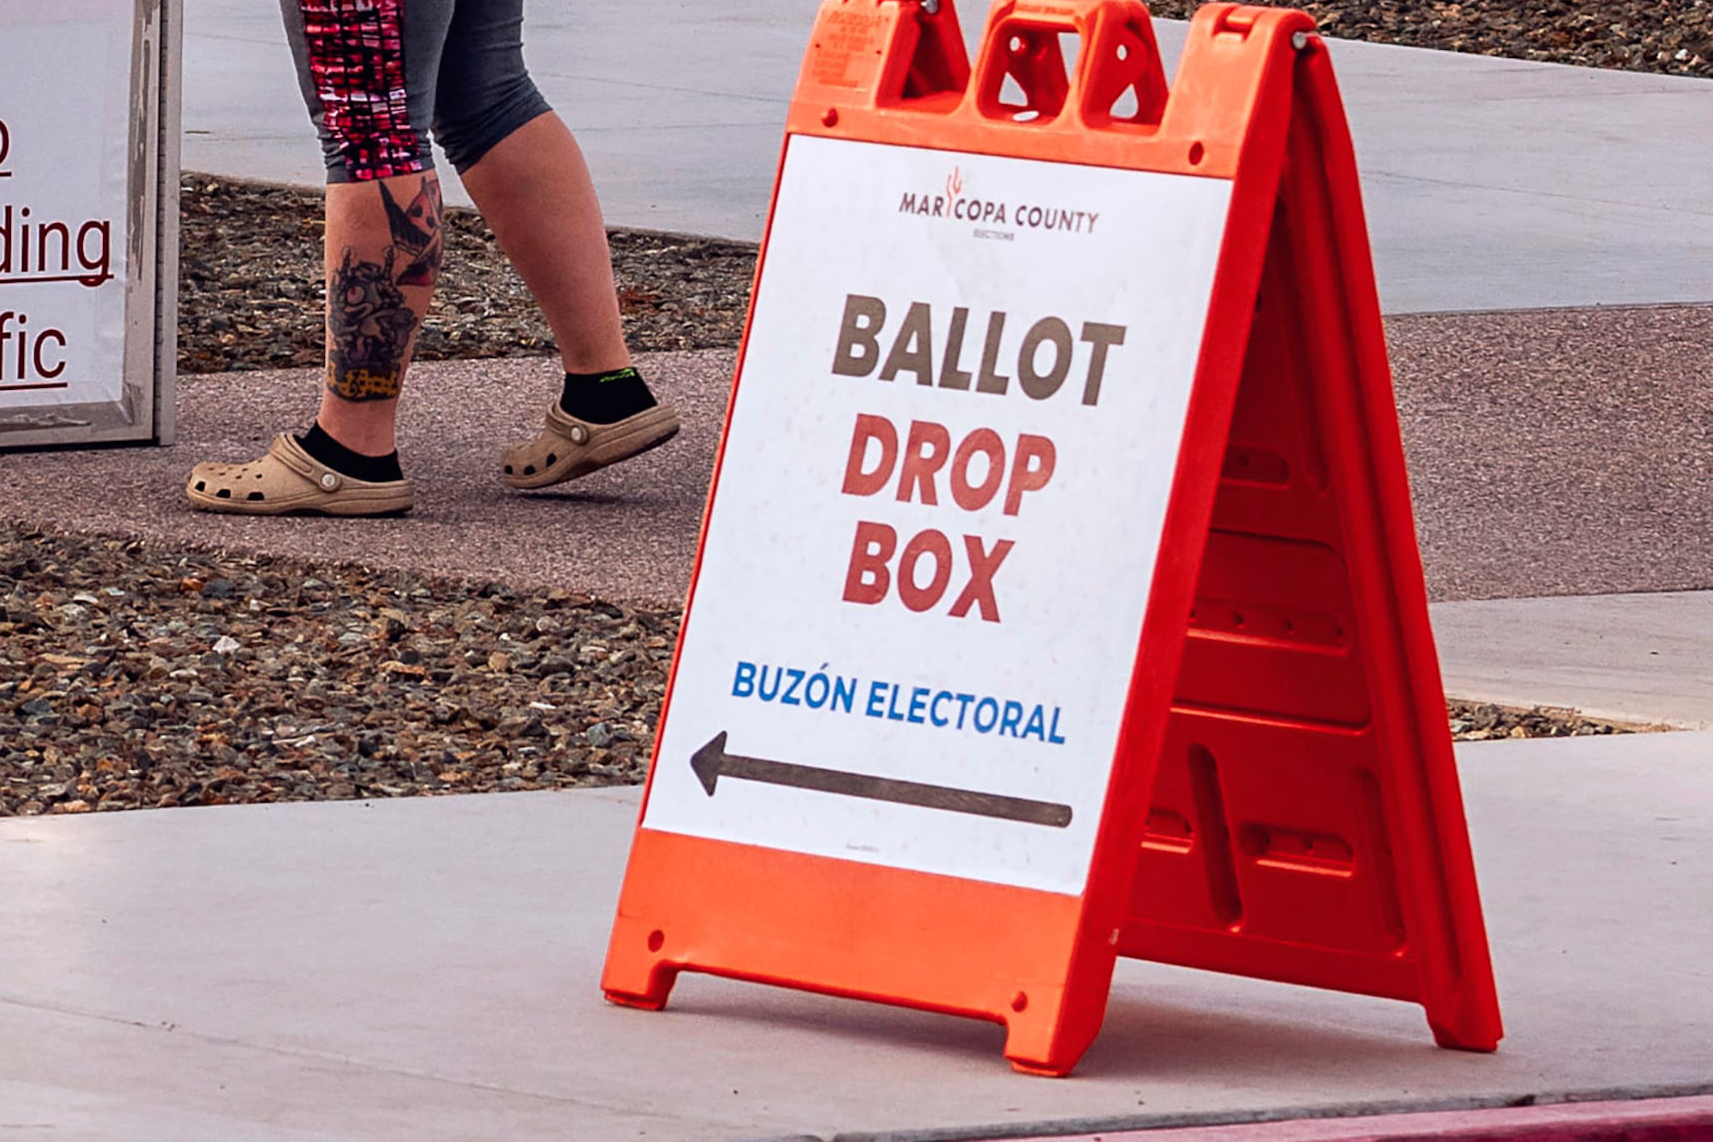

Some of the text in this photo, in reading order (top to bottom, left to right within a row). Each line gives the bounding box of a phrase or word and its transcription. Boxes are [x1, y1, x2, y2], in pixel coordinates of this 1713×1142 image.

[898, 180, 1100, 234] MARICOPA COUNTY
[832, 293, 1127, 407] BALLOT
[841, 412, 1057, 517] DROP
[842, 520, 1016, 624] BOX
[731, 661, 1067, 745] BUZÓN ELECTORAL
